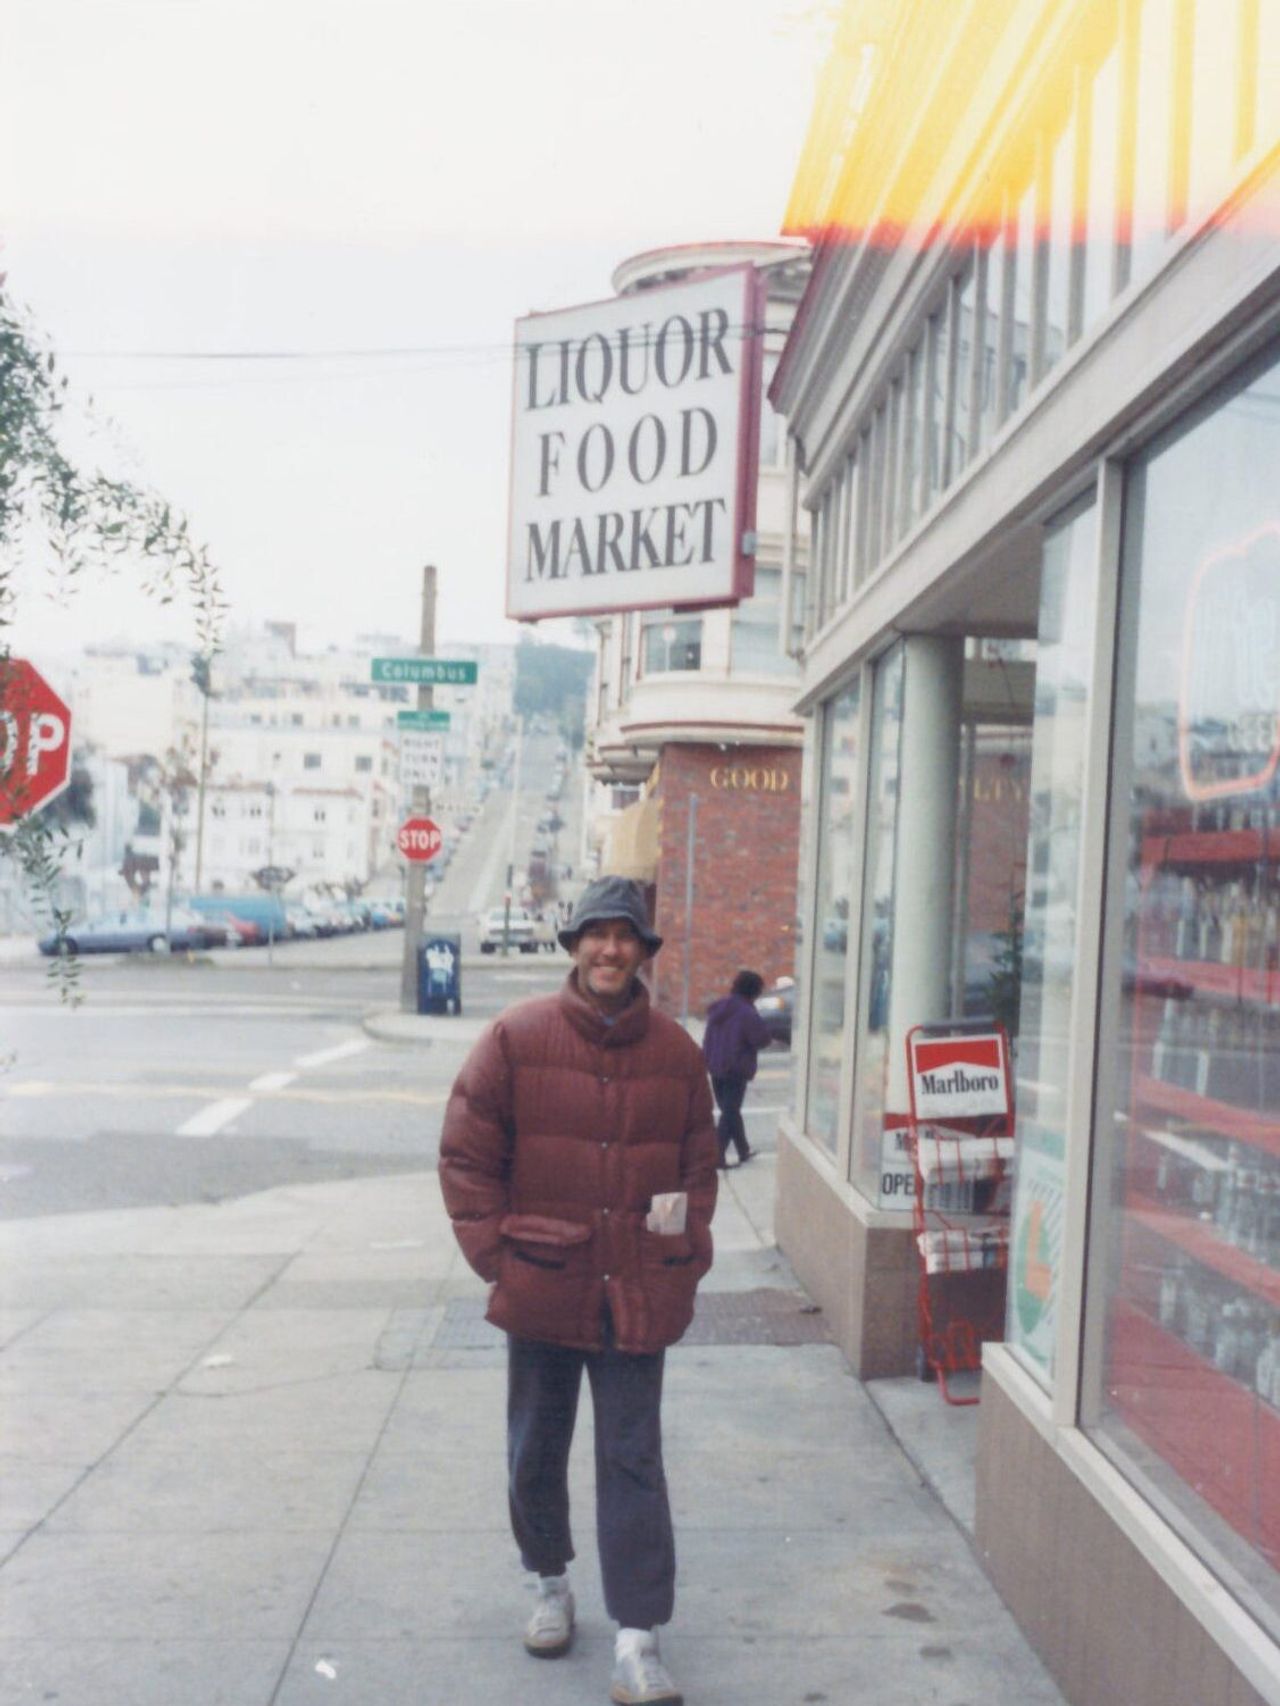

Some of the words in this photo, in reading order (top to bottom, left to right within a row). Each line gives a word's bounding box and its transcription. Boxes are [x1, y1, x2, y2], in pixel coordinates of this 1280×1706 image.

[525, 307, 733, 411] LIQUOR
[536, 406, 717, 498] FOOD
[525, 498, 726, 582] MARKET
[382, 662, 466, 681] Columbus
[710, 767, 788, 792] GOOD
[400, 830, 441, 849] STOP
[922, 1069, 999, 1095] Marlboro
[882, 1173, 917, 1196] OPE
